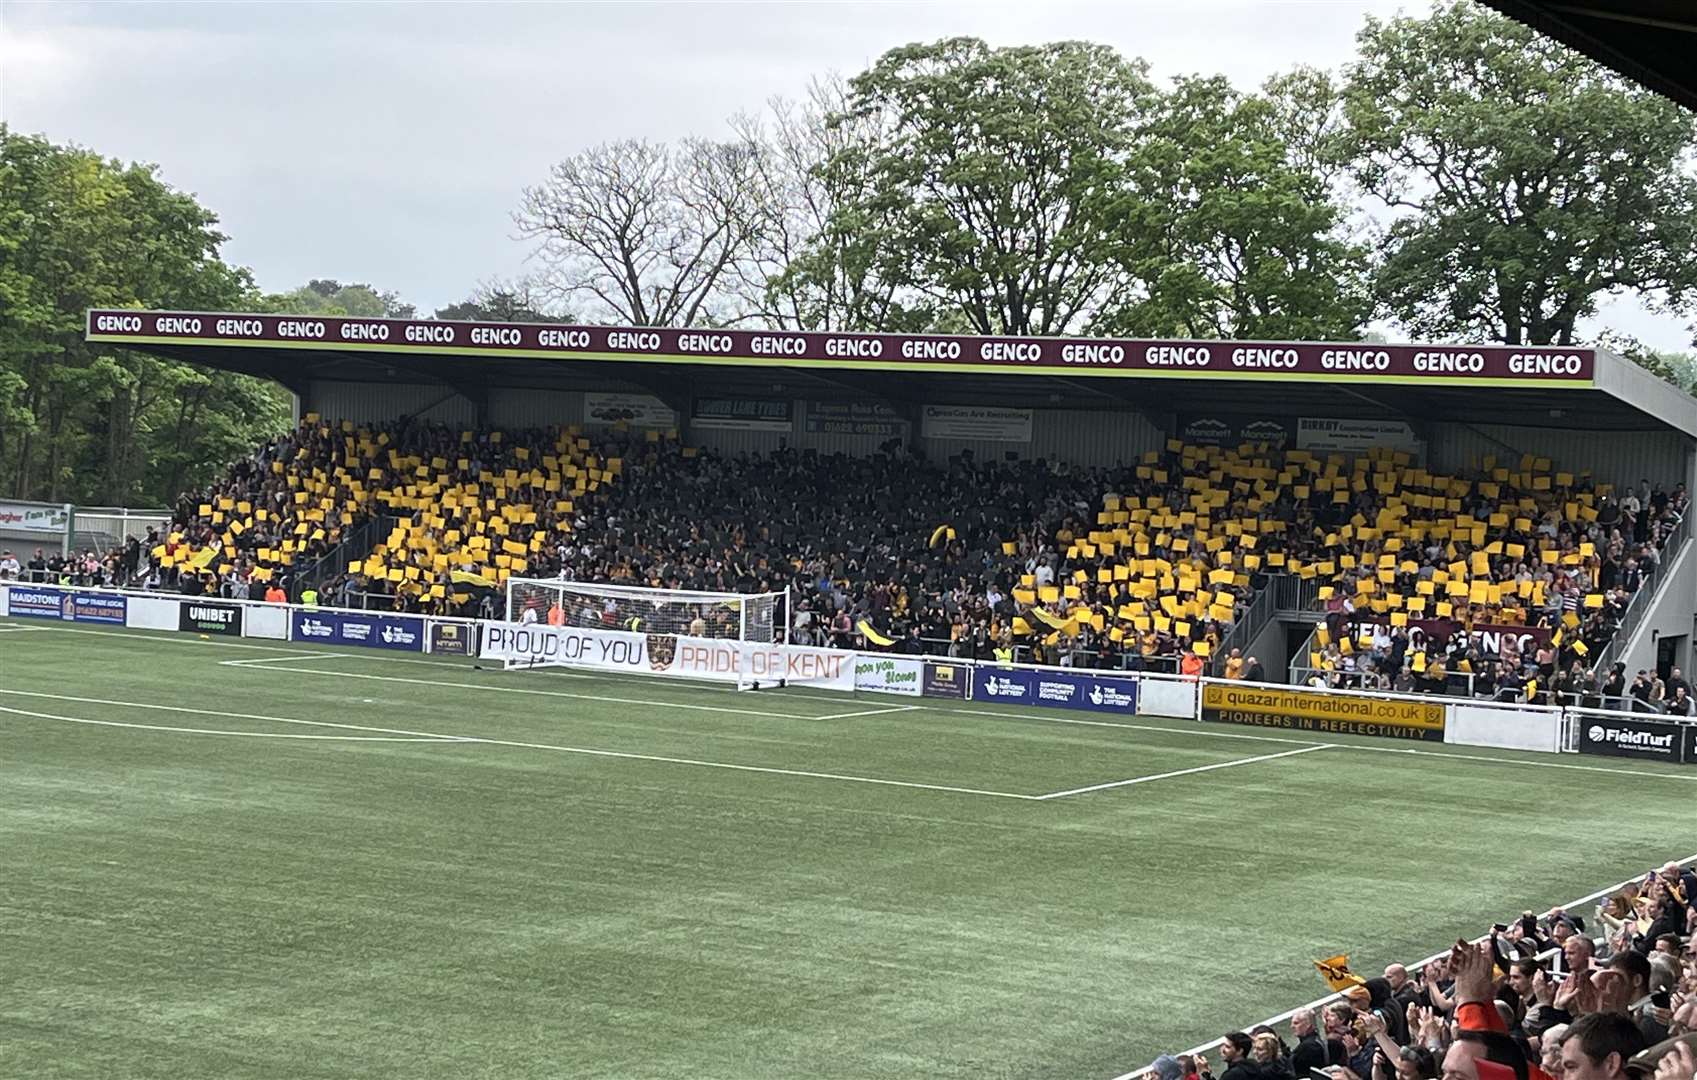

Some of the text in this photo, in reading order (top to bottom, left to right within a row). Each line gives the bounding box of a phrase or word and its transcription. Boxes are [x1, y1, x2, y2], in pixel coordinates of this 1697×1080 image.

[96, 315, 1582, 375] GENCO GENCO GENCO GENCO GENCO GENCO GENCO GENCO GENCO GENCO GENCO GENCO GENCO GENCO GENCO GENCO GENCO GENCO GENCO GENCO
[986, 410, 1030, 421] Recruiting
[10, 592, 61, 606] MAIDSTONE
[189, 606, 235, 623] UNIBET
[488, 628, 642, 665] PROUD OF YOU
[681, 647, 846, 679] PRIDE OF KENT
[1227, 690, 1419, 720] quazarinternational.co.uk
[1219, 710, 1426, 739] PIONEERS IN REFLECTIVITY
[1605, 727, 1673, 747] FieldTurf
